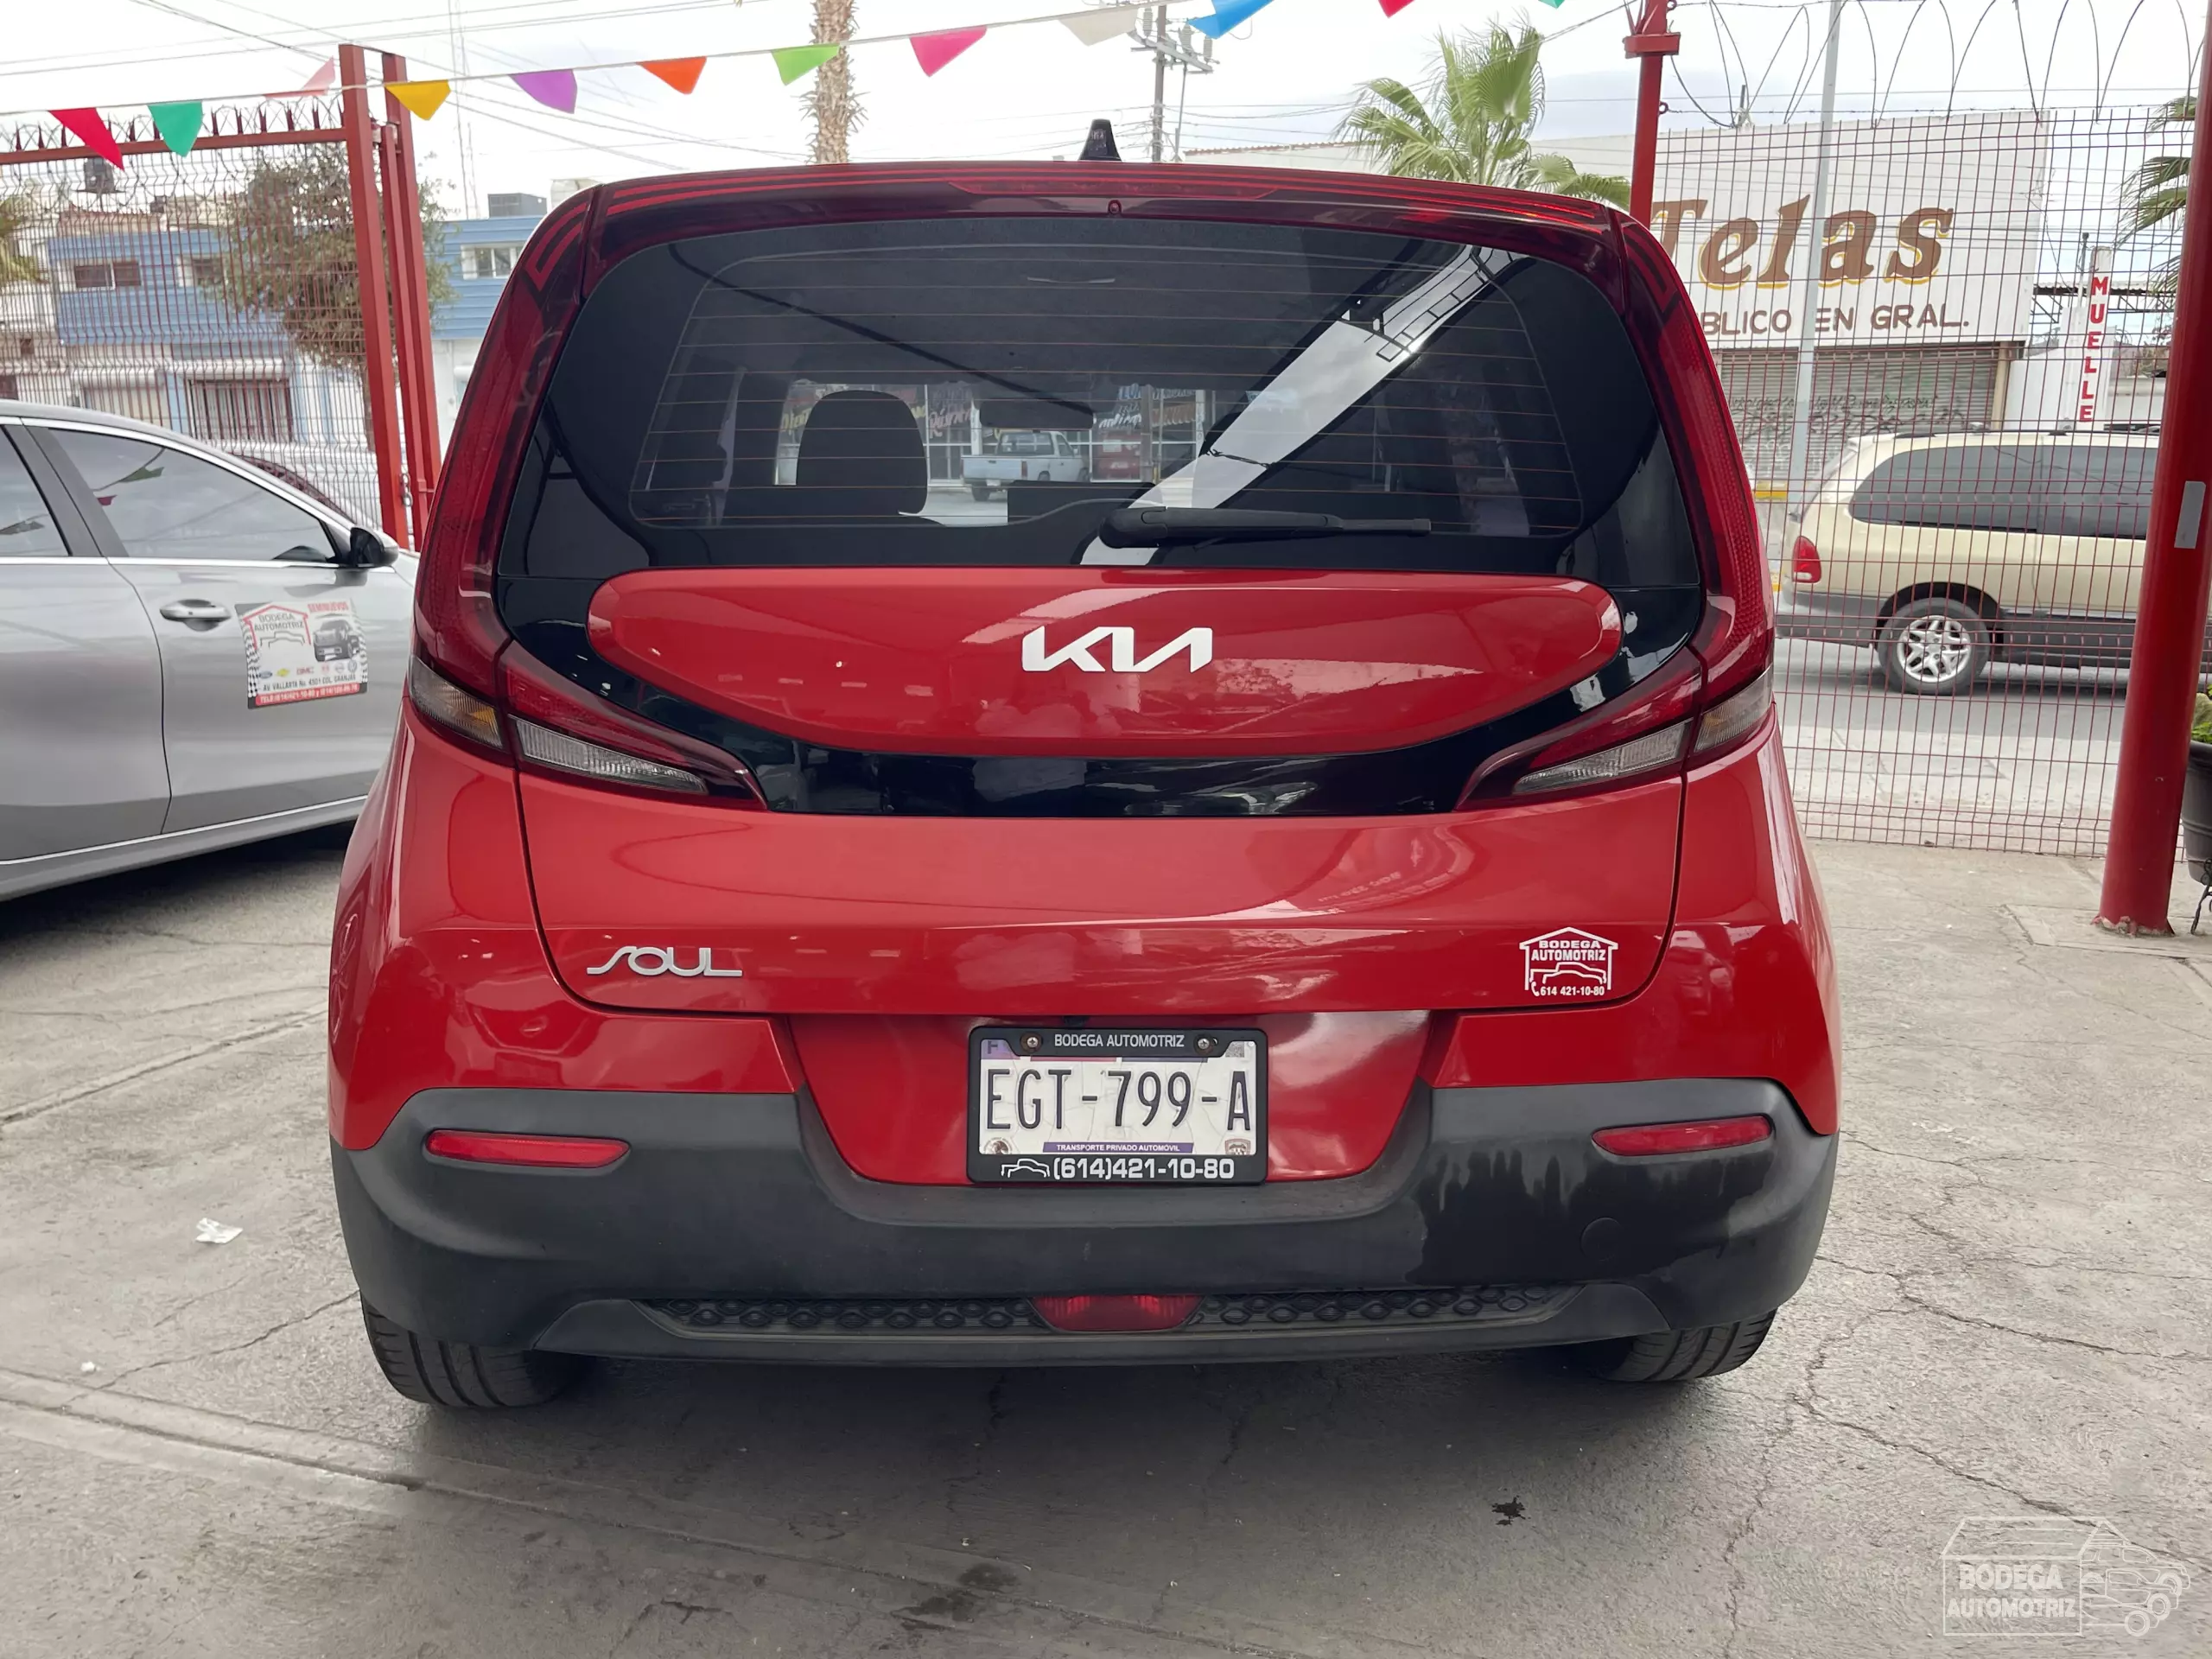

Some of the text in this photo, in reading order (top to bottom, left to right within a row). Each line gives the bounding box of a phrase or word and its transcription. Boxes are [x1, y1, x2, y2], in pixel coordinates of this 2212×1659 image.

[1651, 194, 1955, 290] Telas
[1697, 303, 1970, 335] BLICO EN GRAL.
[2079, 276, 2109, 423] MUELLE
[254, 621, 304, 632] AUTOMOTRIZ
[258, 613, 296, 623] BODEGA
[1539, 940, 1601, 949] BODEGA
[587, 945, 743, 978] SOUL
[1531, 950, 1606, 961] AUTOMOTRIZ
[1540, 986, 1605, 996] 614 421-10-80
[1054, 1033, 1185, 1047] BODEGA AUTOMOTRIZ
[987, 1068, 1251, 1131] EGT-799-A
[1053, 1158, 1235, 1180] (614)421-10-80
